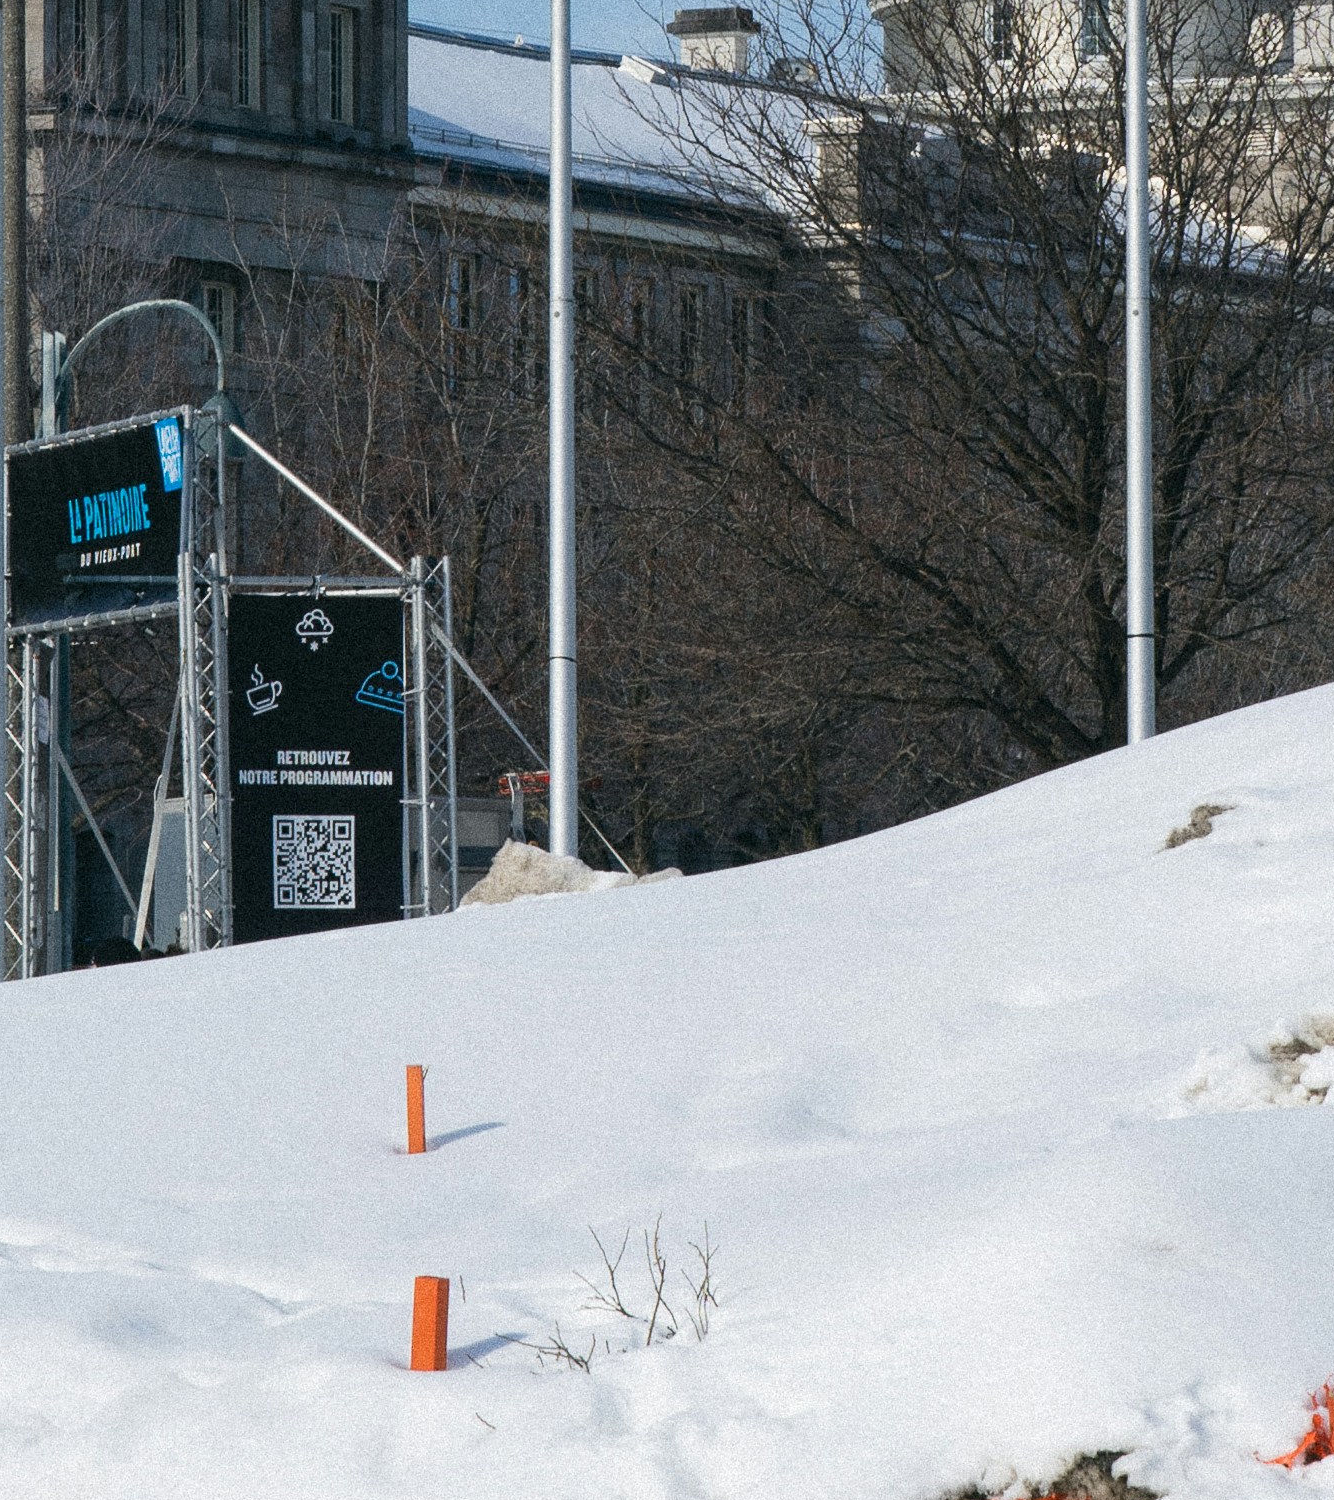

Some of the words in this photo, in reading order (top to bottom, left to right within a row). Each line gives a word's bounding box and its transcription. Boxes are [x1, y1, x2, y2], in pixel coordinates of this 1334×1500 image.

[68, 498, 82, 544] LA
[83, 483, 151, 541] PATINOIRE
[80, 552, 92, 568] DU
[277, 750, 351, 766] RETROUVEZ
[239, 769, 278, 785] NOTRE
[280, 769, 393, 786] PROGRAMMATION
